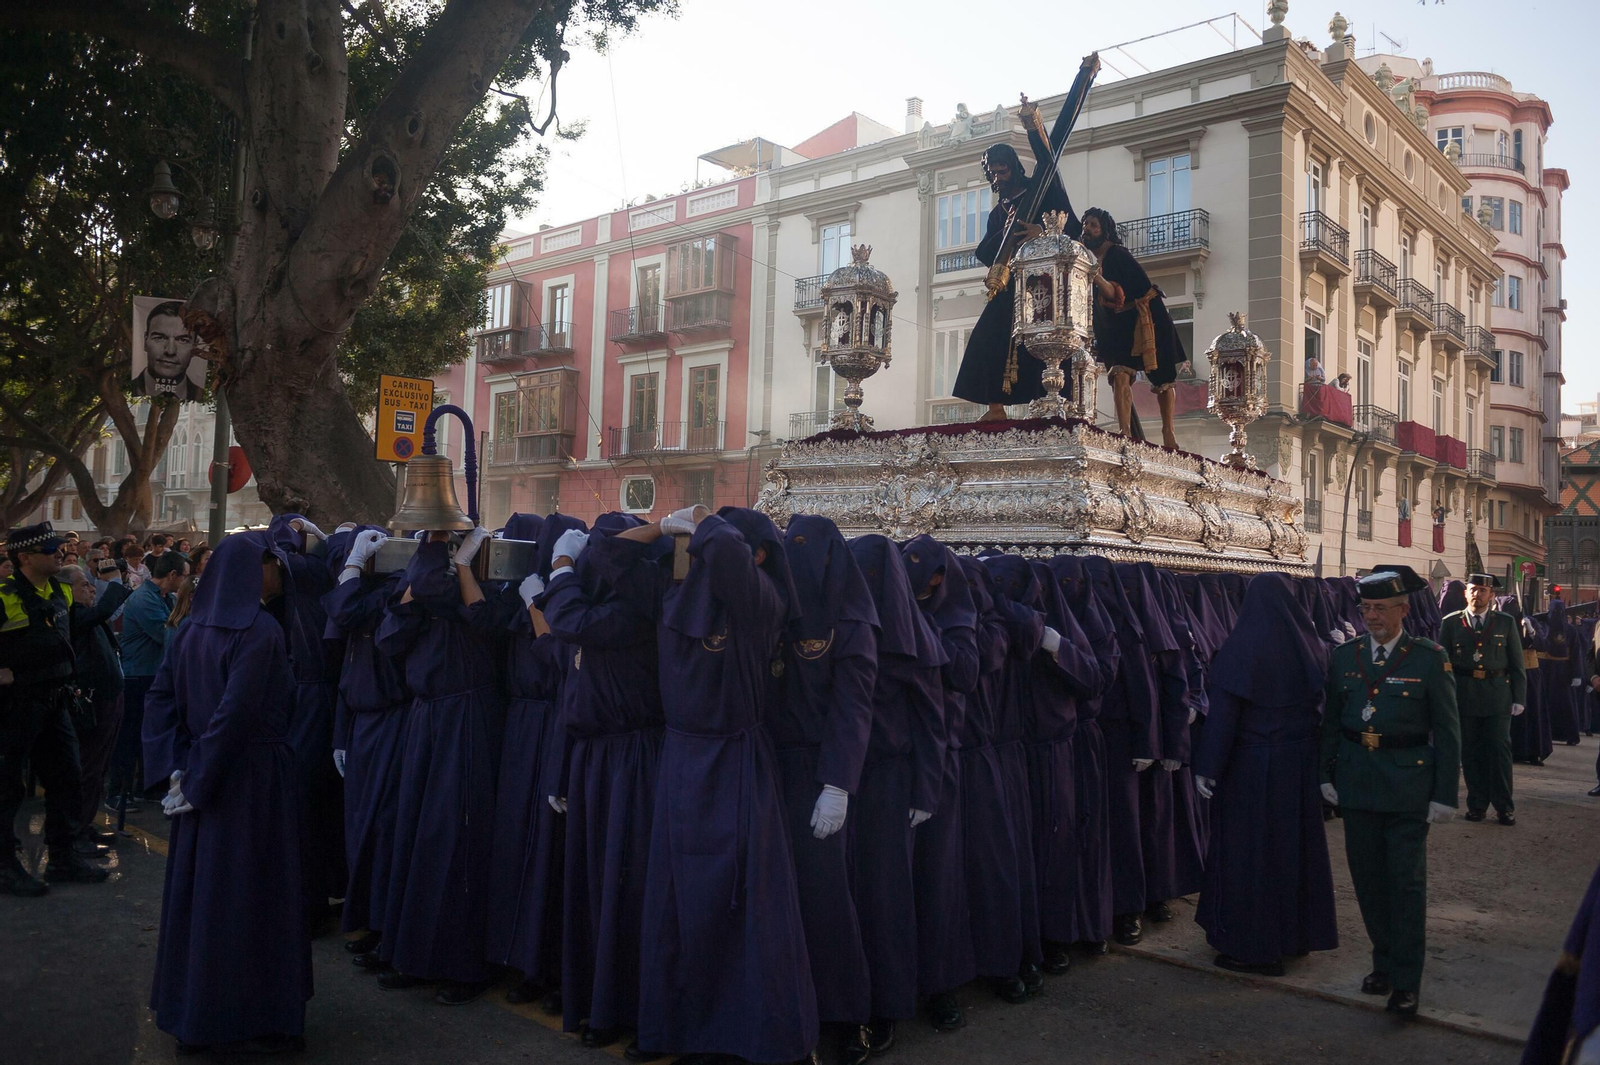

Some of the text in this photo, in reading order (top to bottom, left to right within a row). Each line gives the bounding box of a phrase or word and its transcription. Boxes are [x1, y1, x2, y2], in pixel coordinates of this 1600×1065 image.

[154, 384, 177, 393] PSOE
[392, 380, 422, 391] CARRIL
[383, 388, 429, 401] EXCLUSIVO
[384, 398, 401, 407] BUS
[409, 401, 428, 410] TAXI
